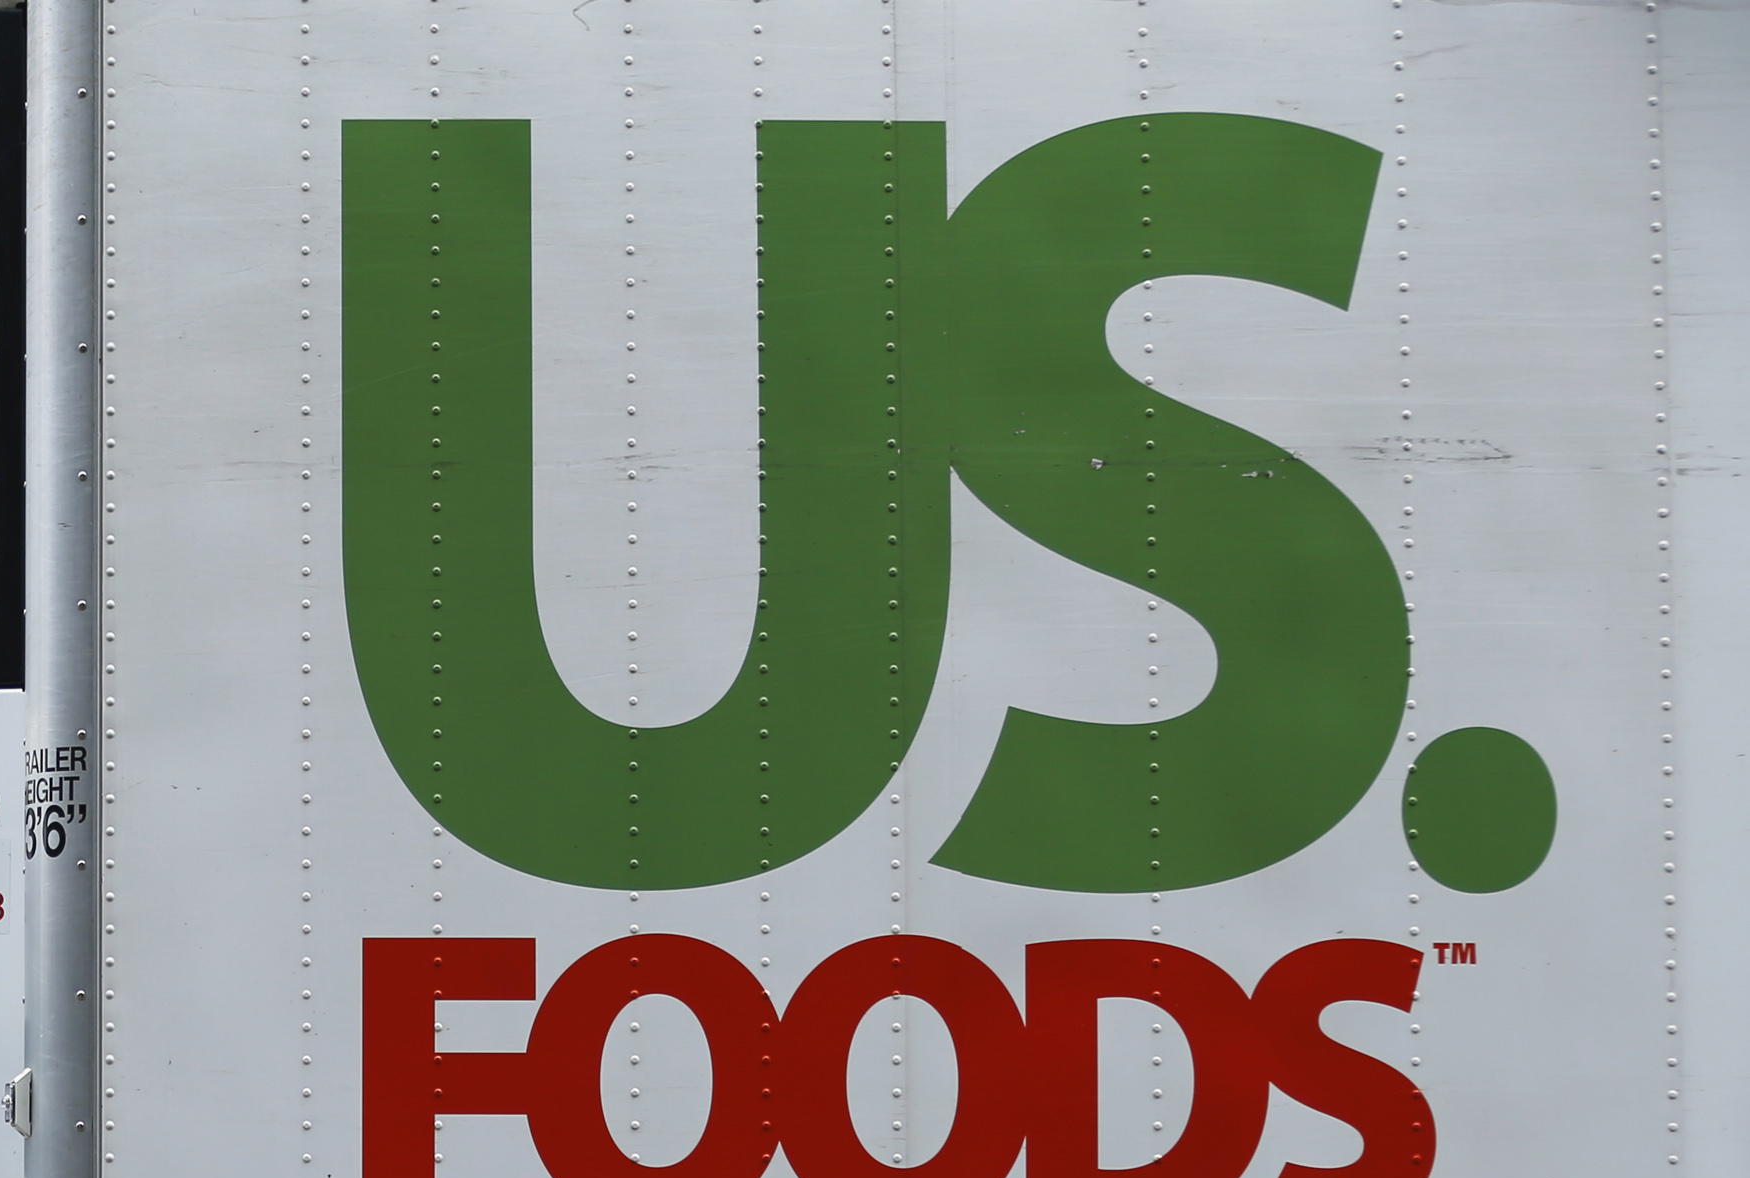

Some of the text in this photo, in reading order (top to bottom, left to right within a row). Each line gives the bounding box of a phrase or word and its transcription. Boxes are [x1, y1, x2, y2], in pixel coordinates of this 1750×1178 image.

[342, 112, 1556, 893] US.
[25, 746, 87, 775] RAILER
[25, 776, 80, 804] EIGHT
[25, 804, 87, 860] 3'6"
